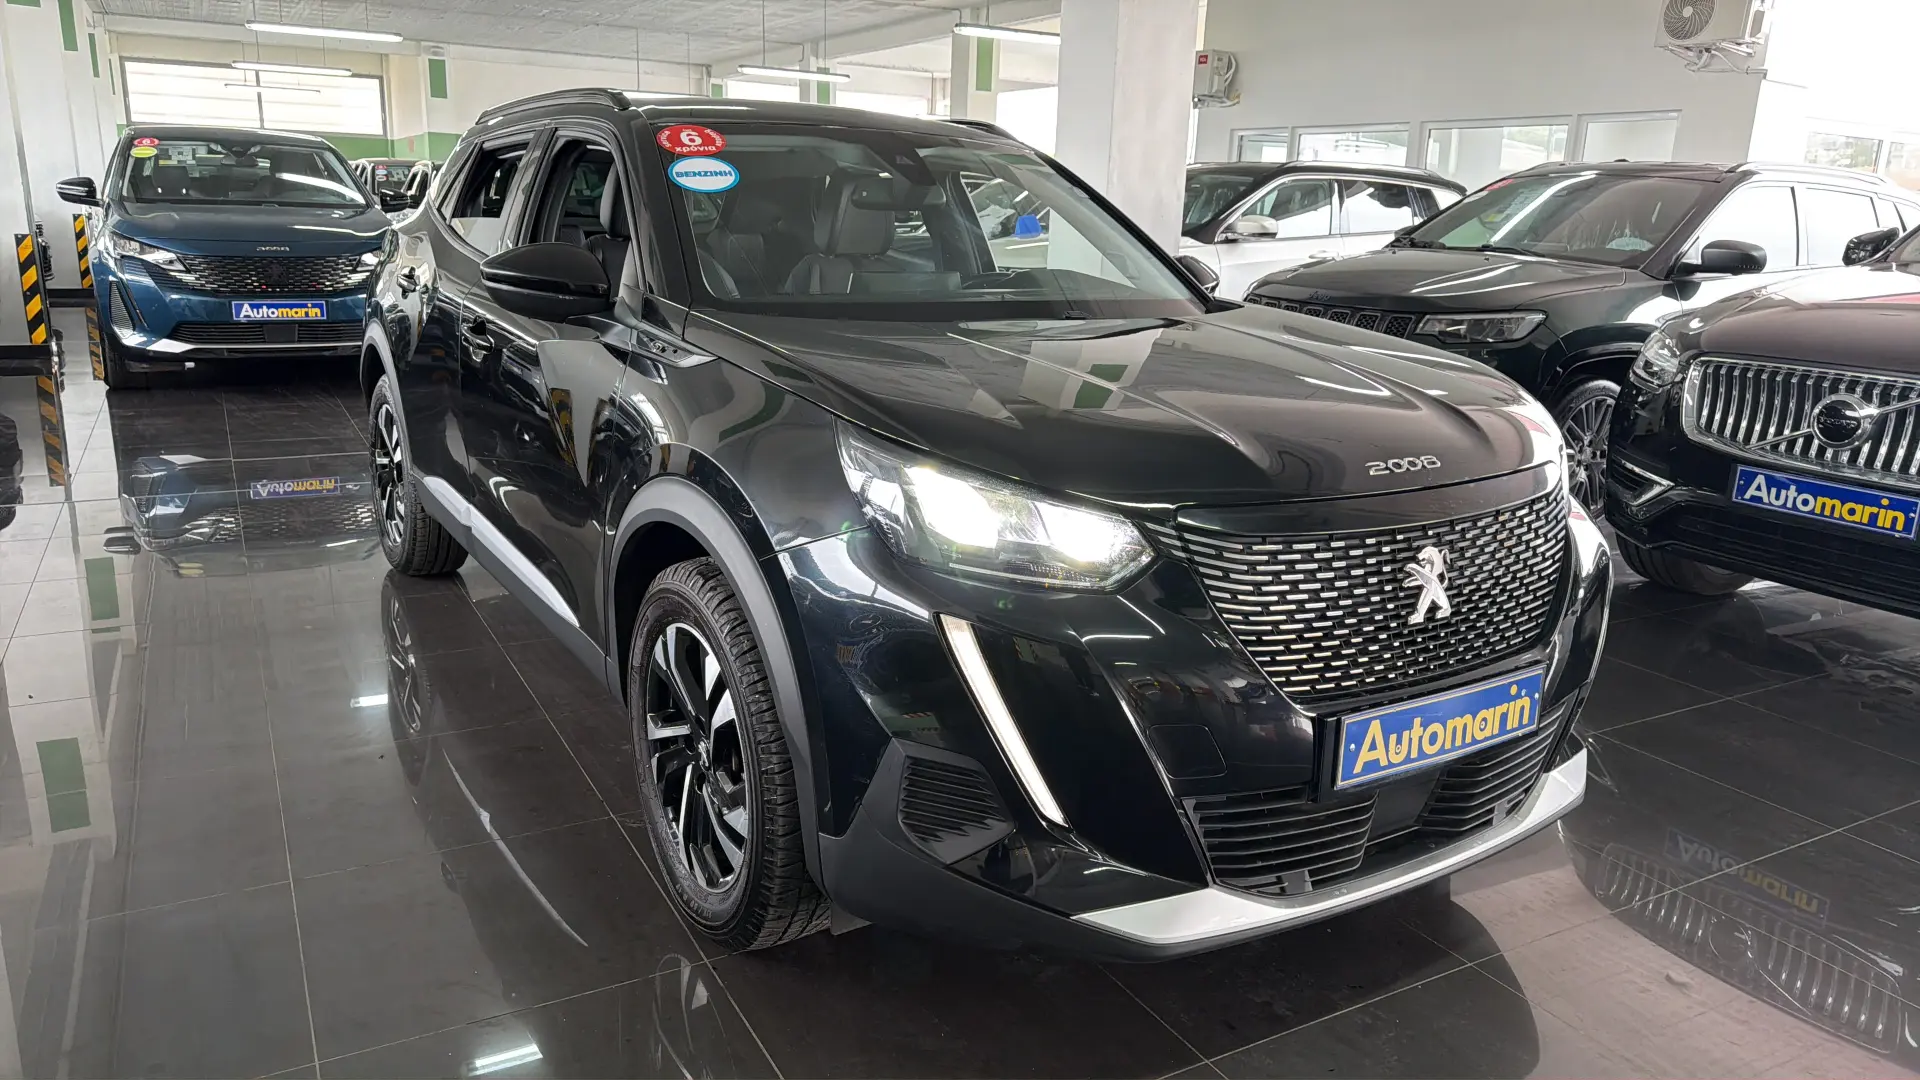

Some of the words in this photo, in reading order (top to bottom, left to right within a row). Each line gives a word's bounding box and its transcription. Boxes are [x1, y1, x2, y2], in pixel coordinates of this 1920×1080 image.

[680, 131, 702, 146] 6
[240, 303, 321, 318] Automarin
[1364, 455, 1441, 475] 2008
[1743, 474, 1906, 531] Automarin
[1352, 684, 1531, 775] Automarin
